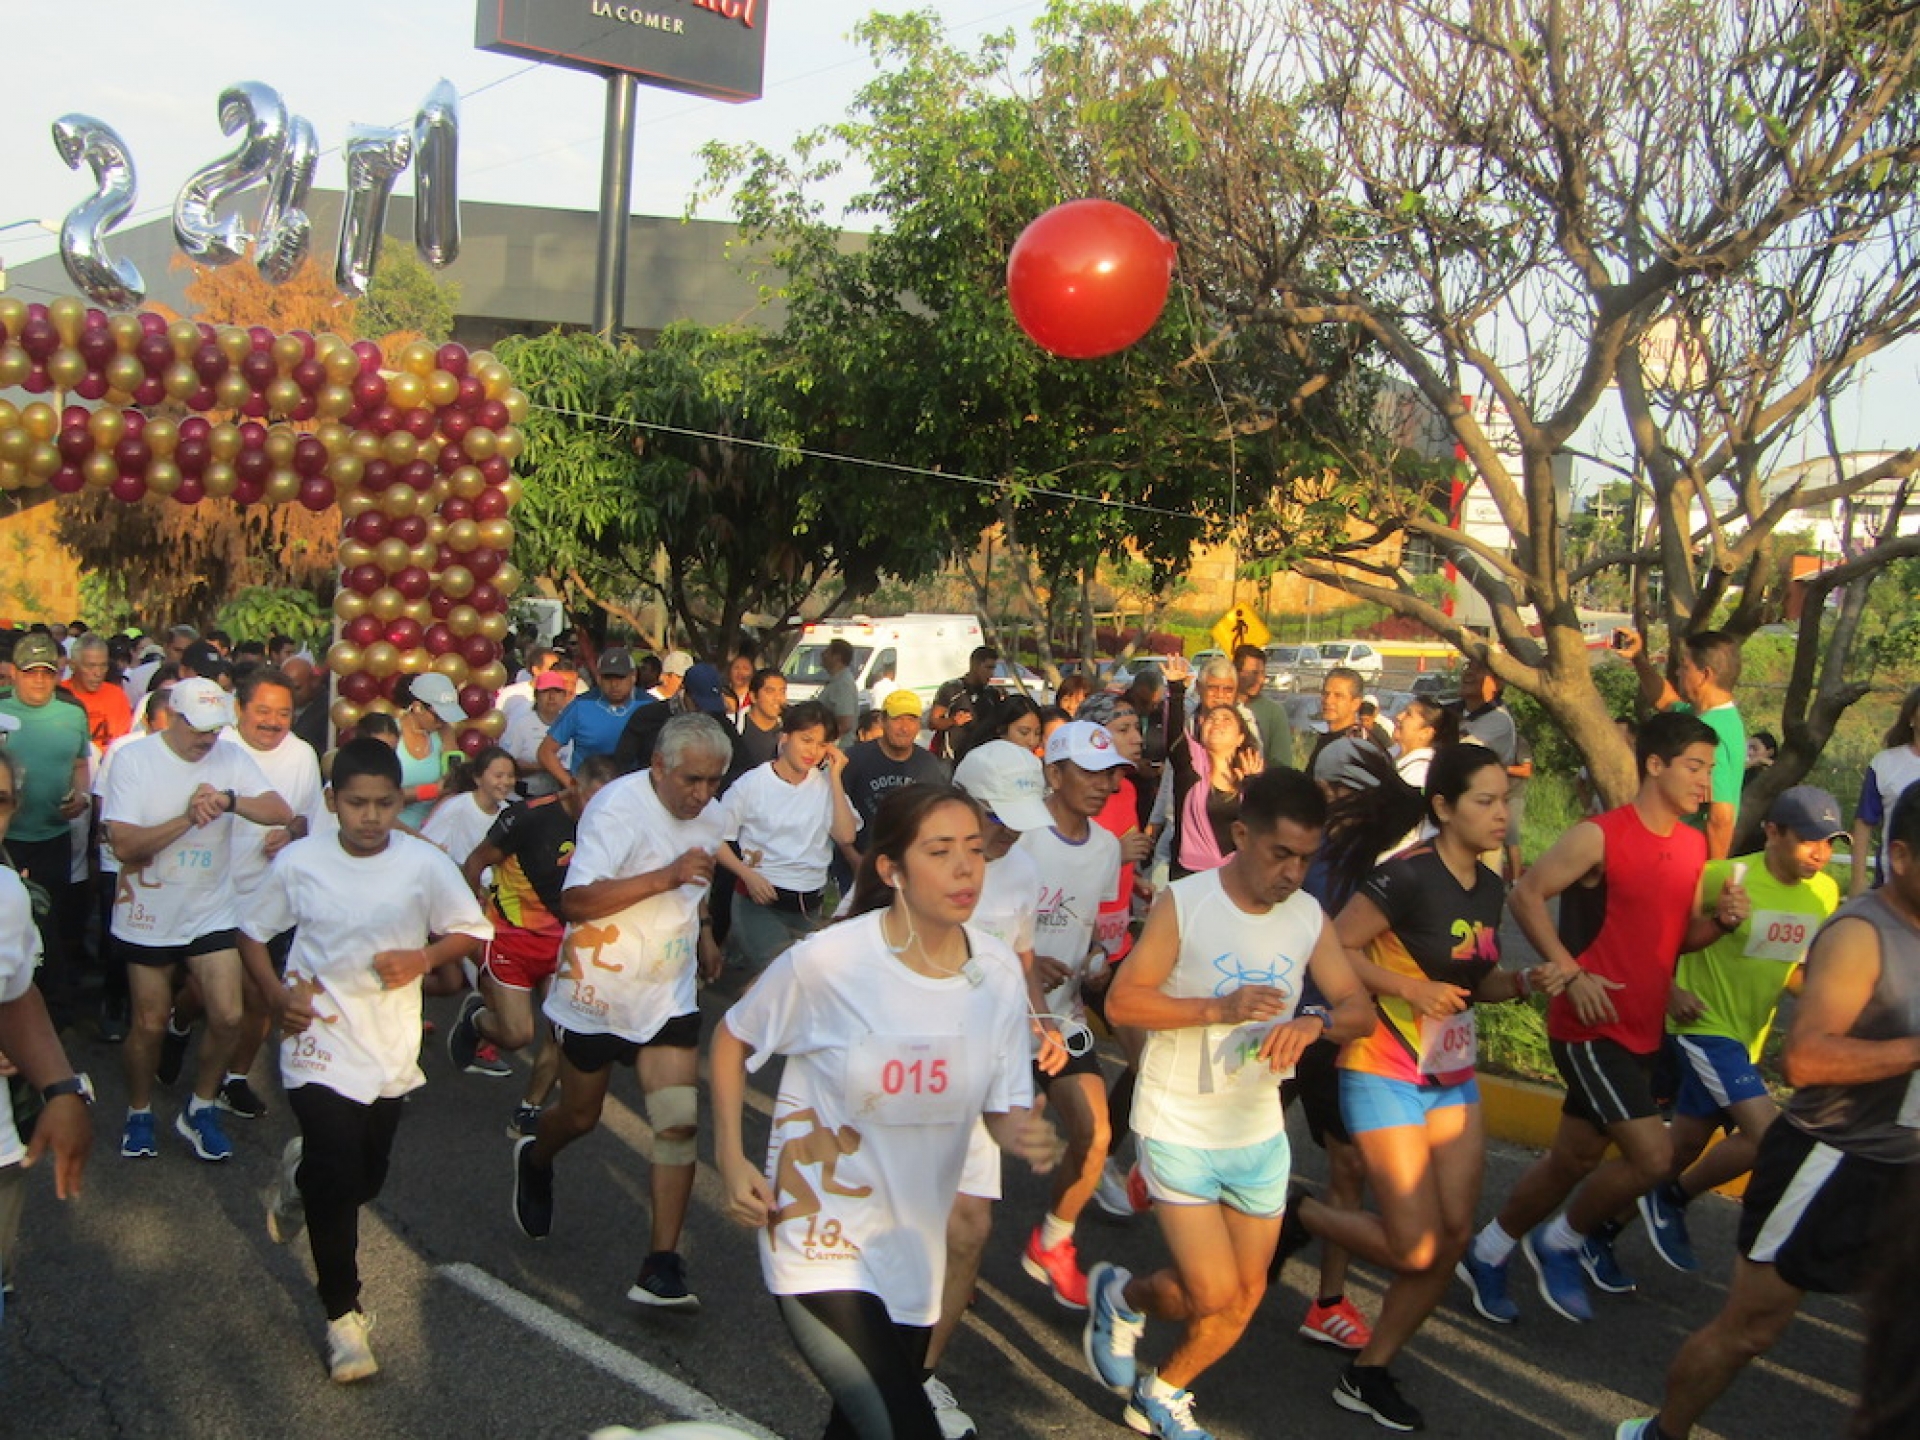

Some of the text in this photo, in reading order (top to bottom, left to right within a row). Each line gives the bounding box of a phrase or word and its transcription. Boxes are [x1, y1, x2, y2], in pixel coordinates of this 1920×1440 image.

[616, 6, 685, 35] COMER
[176, 848, 213, 868] 178
[1767, 921, 1806, 944] 039
[881, 1058, 949, 1095] 015
